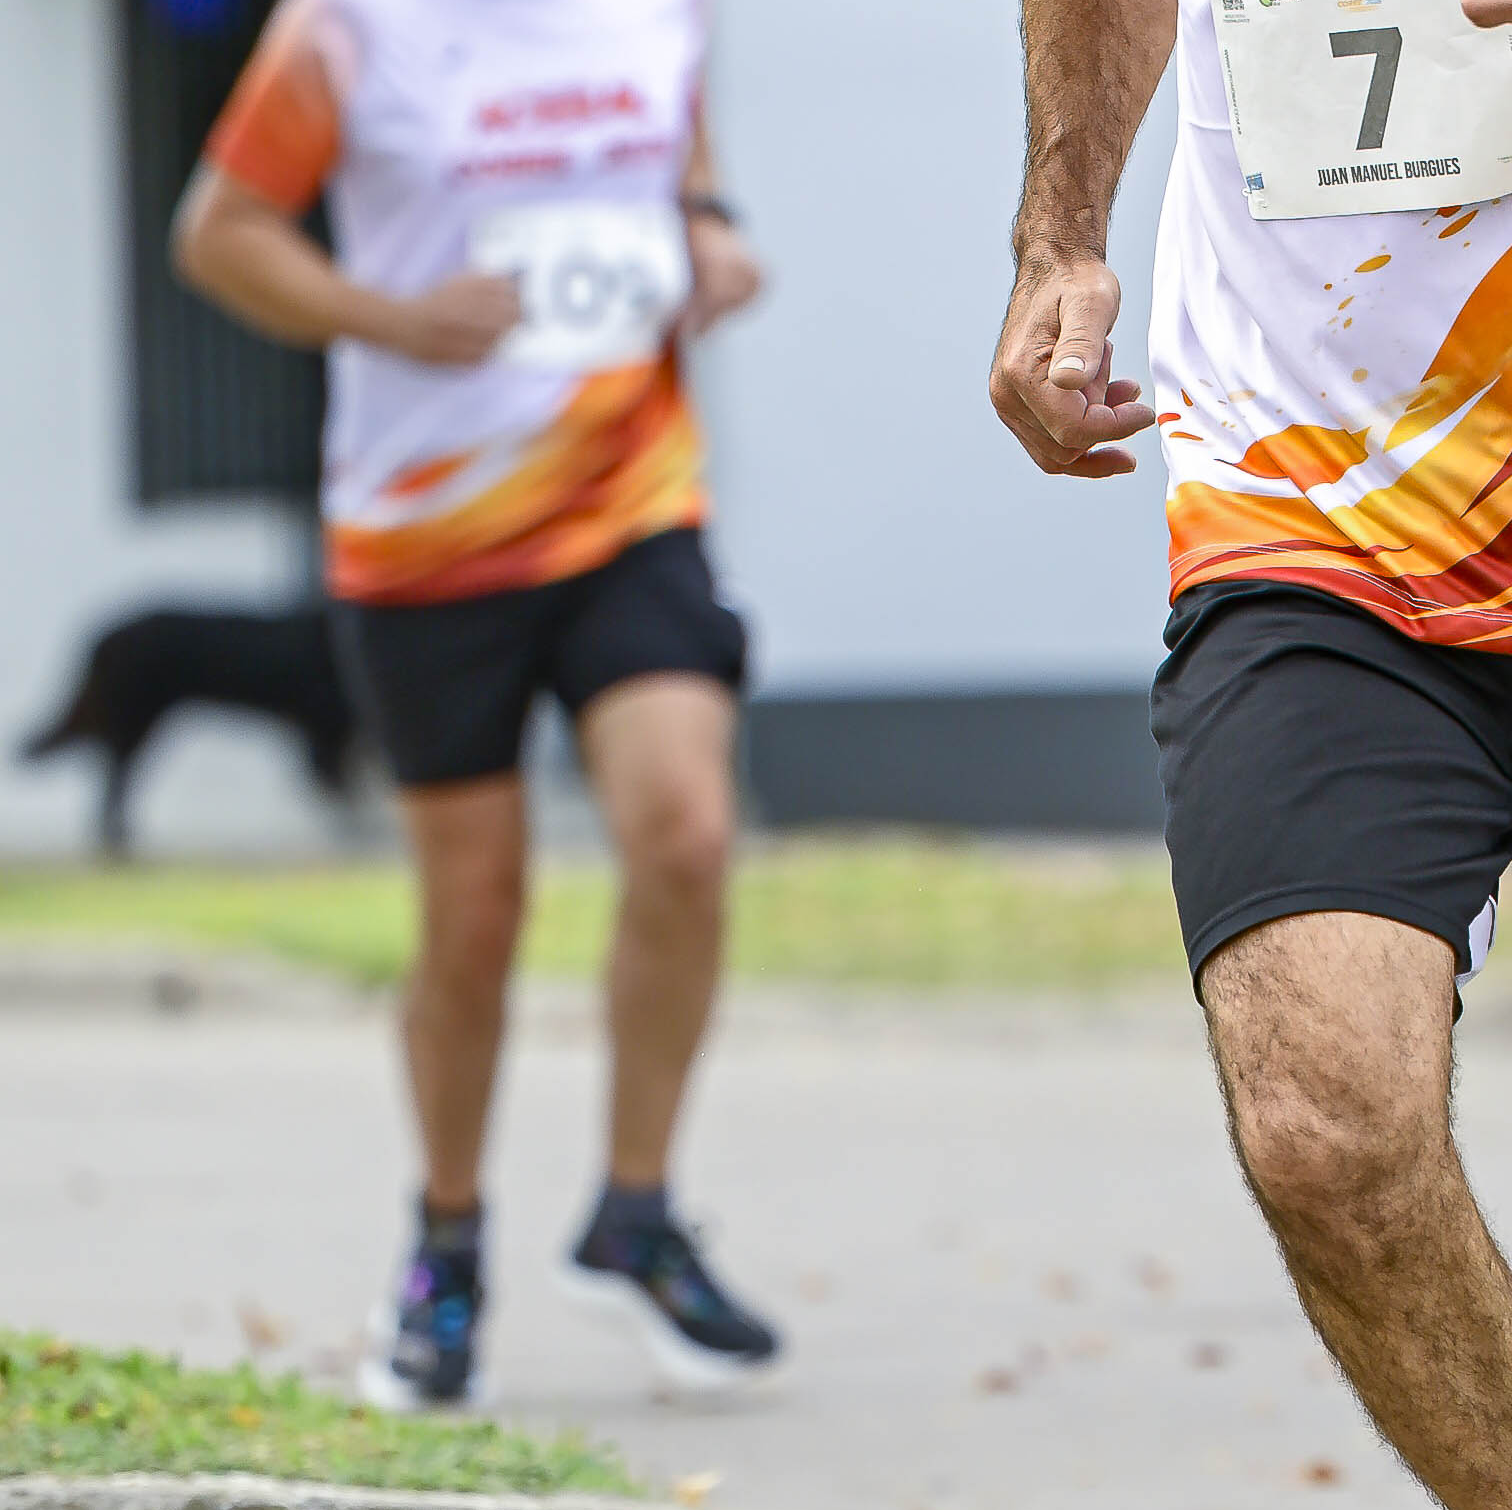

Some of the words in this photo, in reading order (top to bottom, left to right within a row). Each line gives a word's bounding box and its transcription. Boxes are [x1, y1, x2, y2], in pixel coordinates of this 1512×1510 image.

[1329, 27, 1403, 151] 7
[1317, 167, 1349, 187] JUAN
[1350, 162, 1403, 184] MANUEL
[1403, 157, 1461, 179] BURGUES
